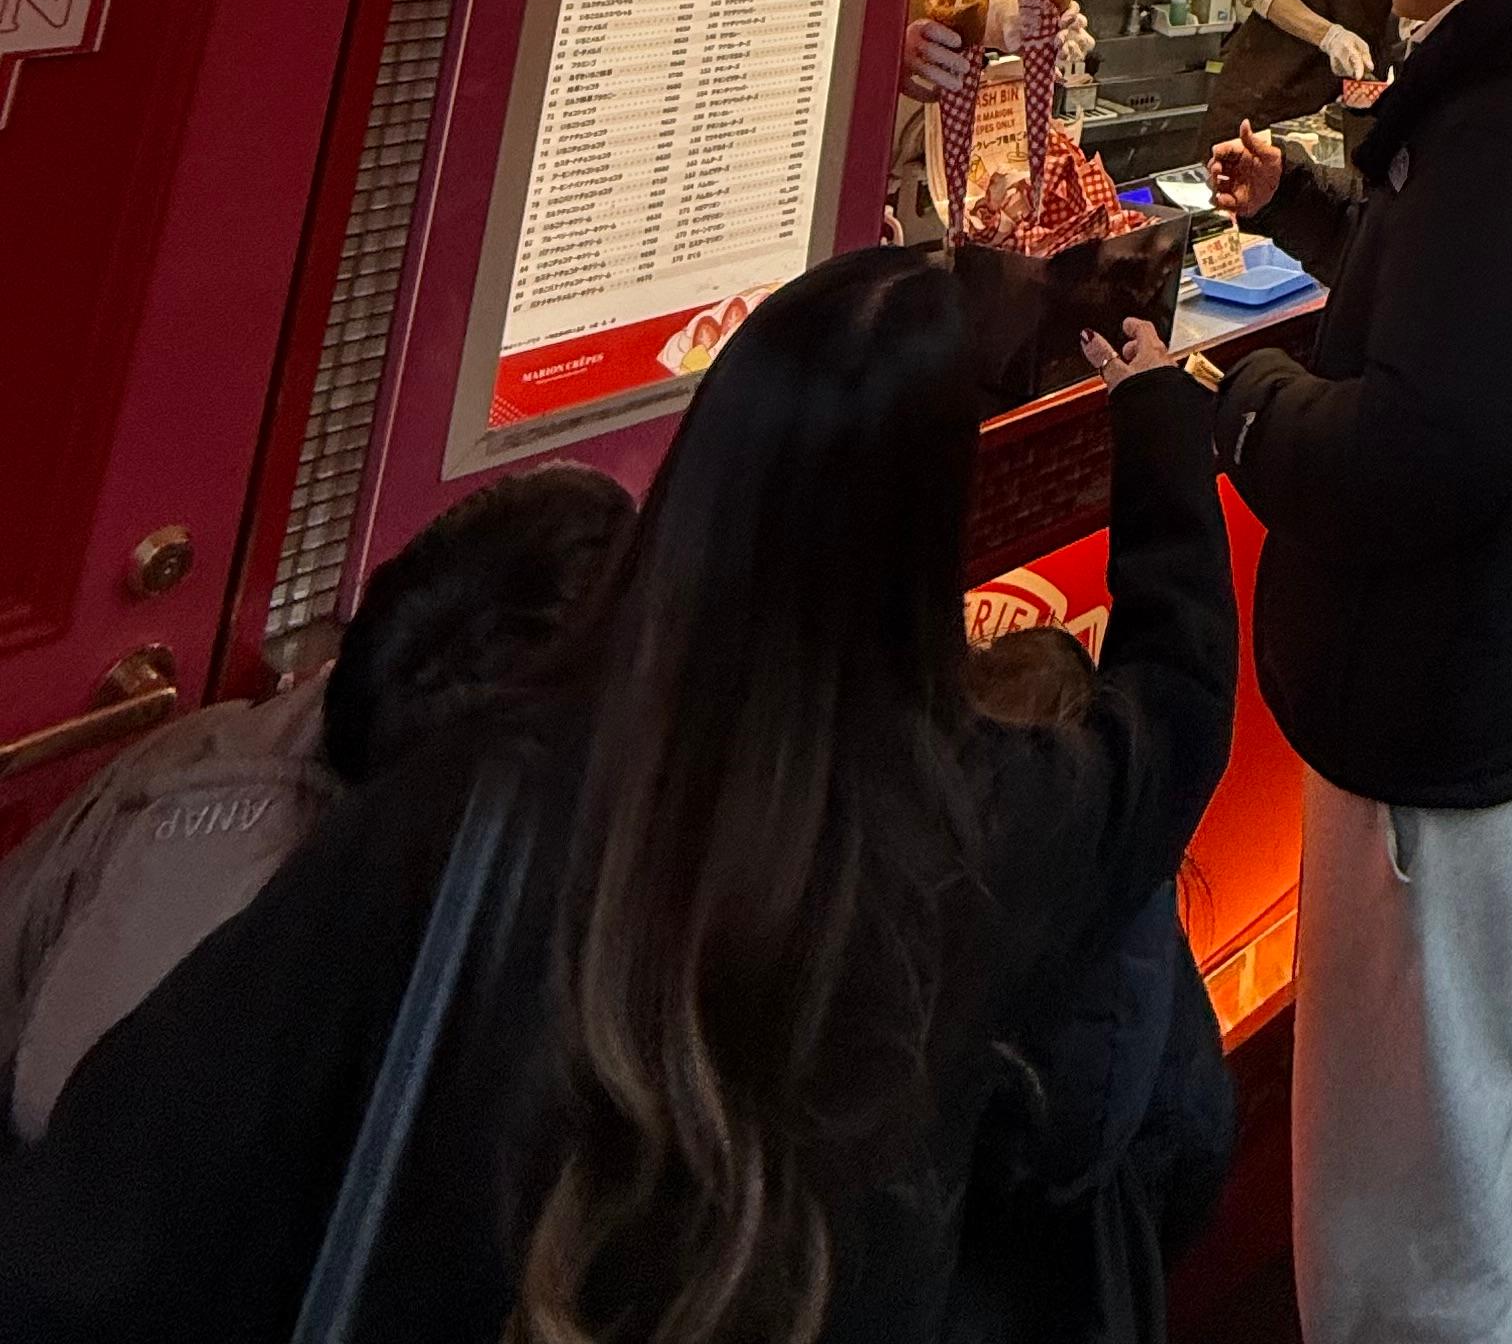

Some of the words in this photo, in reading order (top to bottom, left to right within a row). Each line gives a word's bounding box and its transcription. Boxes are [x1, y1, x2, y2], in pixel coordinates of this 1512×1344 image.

[976, 89, 997, 109] ASH
[1000, 87, 1019, 103] BIN
[996, 118, 1015, 131] ONLY
